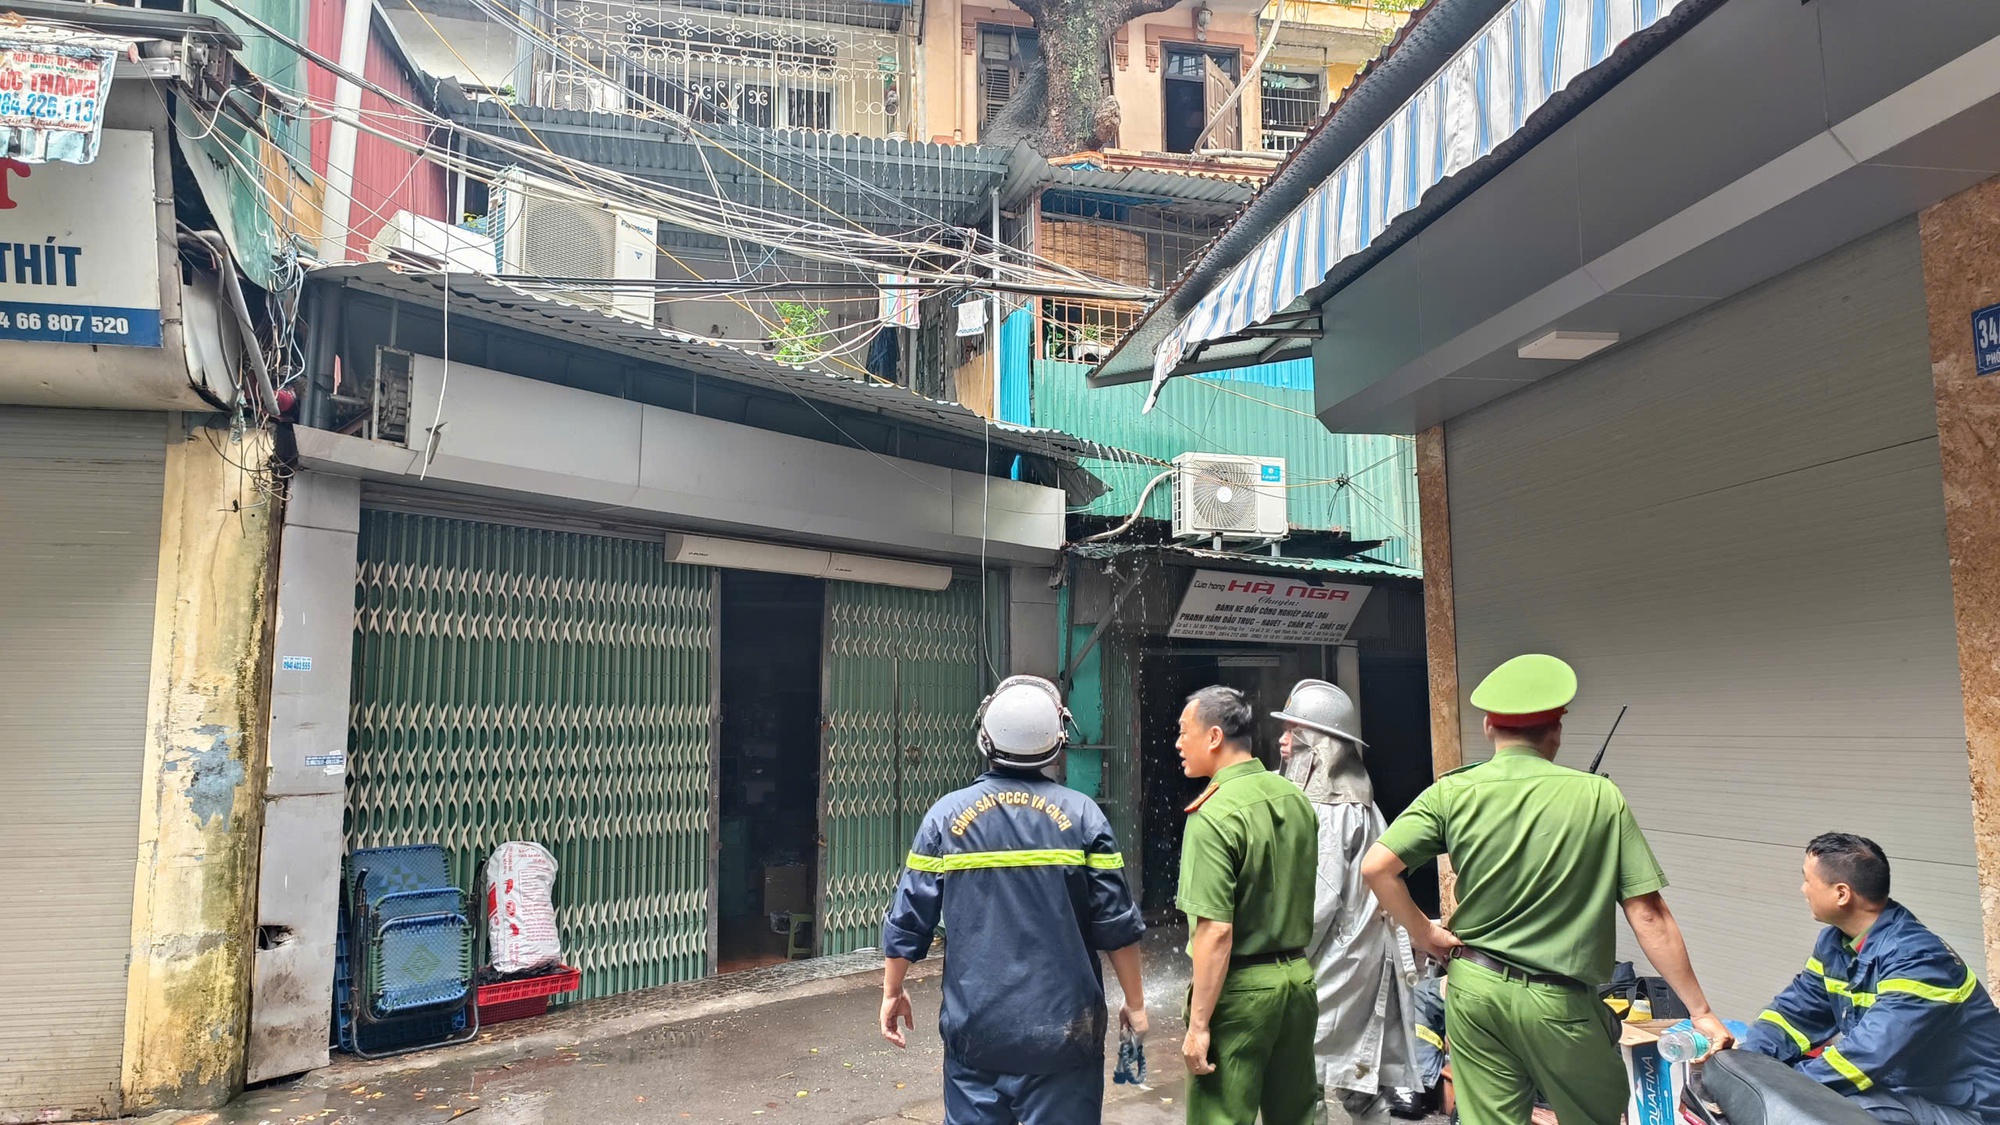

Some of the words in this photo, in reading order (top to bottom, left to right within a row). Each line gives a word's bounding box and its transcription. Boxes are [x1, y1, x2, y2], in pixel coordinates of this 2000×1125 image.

[30, 71, 96, 98] THÀNH
[0, 91, 94, 122] 84.226.113
[16, 312, 41, 330] 66
[47, 314, 85, 332] 807
[91, 316, 129, 334] 520
[1978, 314, 2000, 349] 34
[1227, 579, 1276, 595] HÀ
[1285, 585, 1350, 602] NGA
[1180, 612, 1204, 622] PHANH
[951, 806, 978, 836] CẢNH
[975, 794, 998, 813] SÁT
[998, 791, 1030, 805] PCCC
[1045, 803, 1073, 832] CNCH
